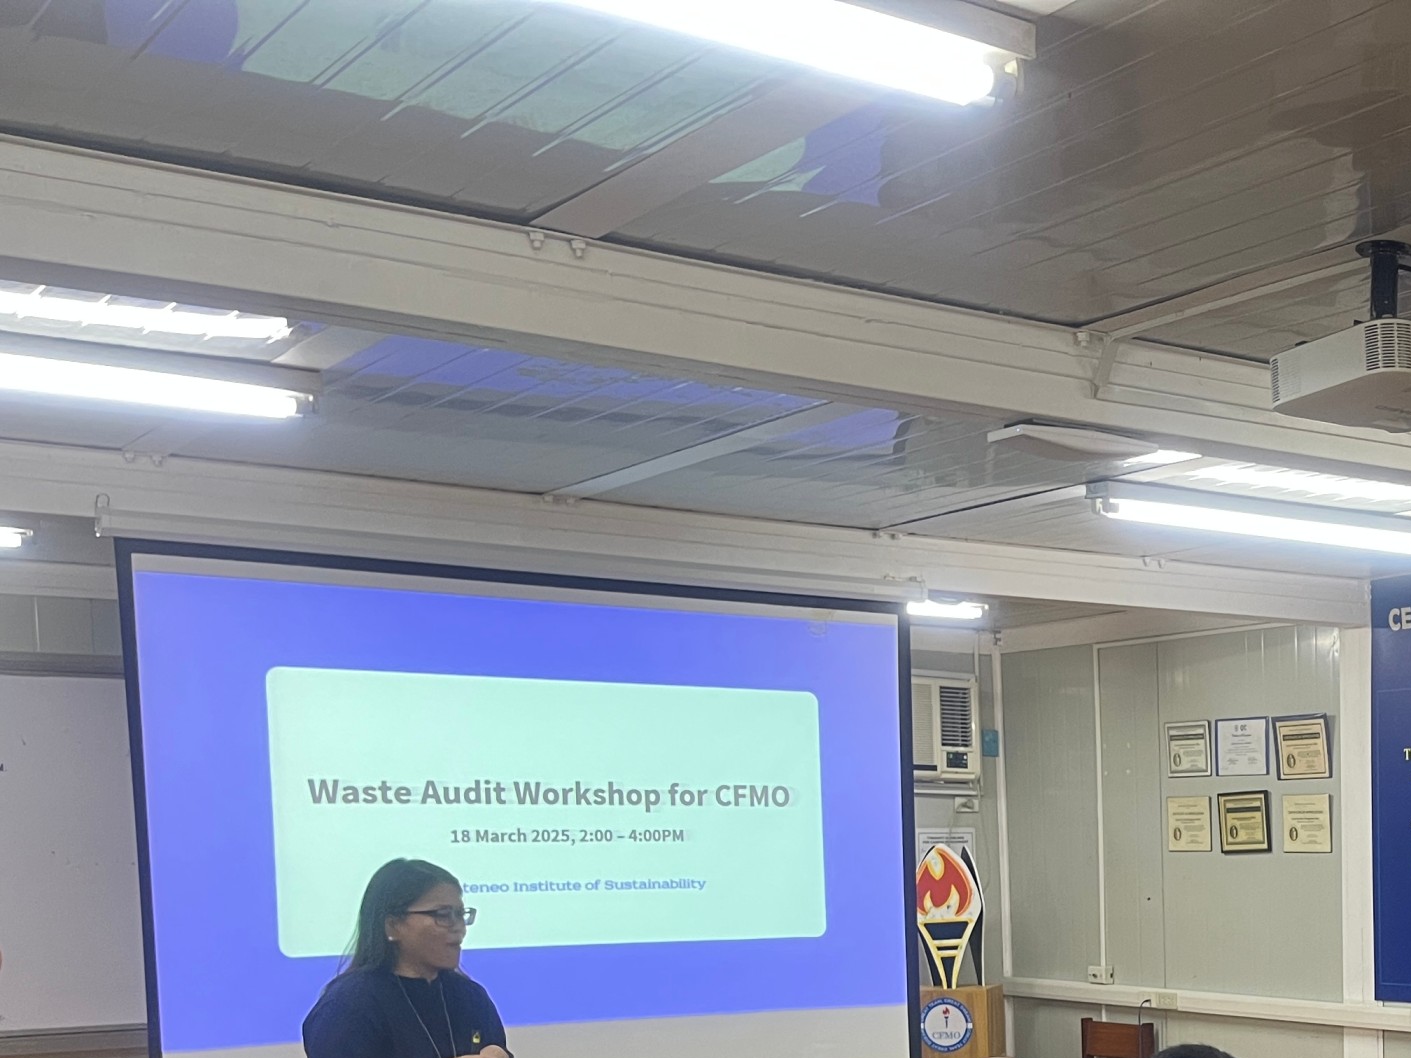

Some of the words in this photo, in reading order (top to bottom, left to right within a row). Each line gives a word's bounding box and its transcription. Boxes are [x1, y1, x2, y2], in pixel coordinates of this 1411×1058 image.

[308, 778, 412, 805] Waste
[421, 779, 506, 805] Audit
[514, 781, 661, 813] Workshop
[668, 783, 704, 807] for
[714, 784, 790, 809] CFMO
[450, 828, 471, 843] 18
[475, 828, 527, 843] March
[532, 828, 576, 846] 2025,
[580, 828, 613, 843] 2:00
[628, 828, 684, 843] 4:00PM
[461, 881, 510, 894] teneo
[513, 879, 582, 893] Institute
[585, 878, 601, 892] of
[605, 877, 707, 893] Sustainability
